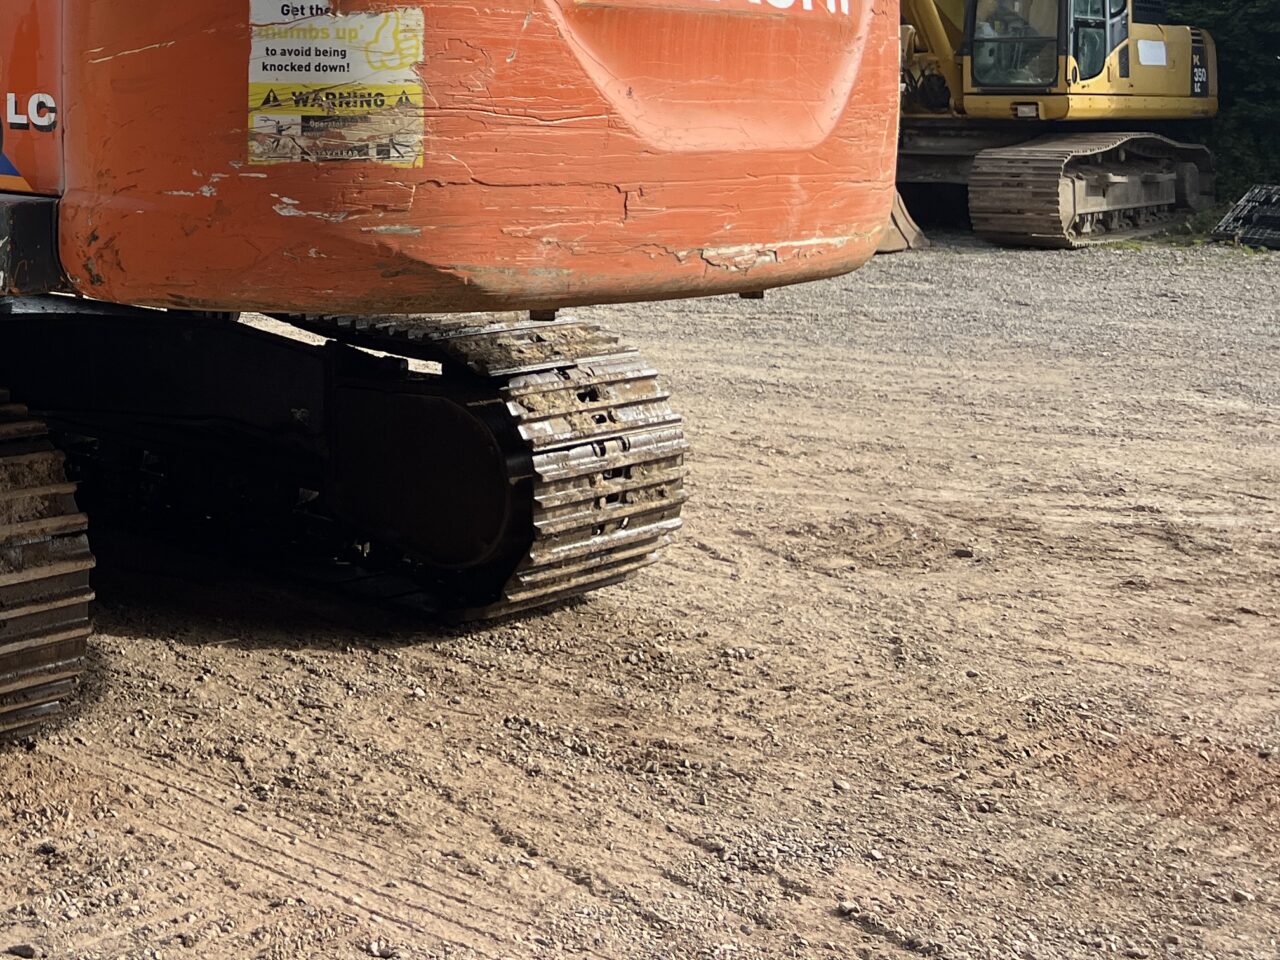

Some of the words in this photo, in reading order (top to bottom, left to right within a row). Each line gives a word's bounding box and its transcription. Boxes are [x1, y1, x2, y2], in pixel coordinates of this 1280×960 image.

[281, 4, 305, 16] Get
[265, 47, 277, 57] to
[280, 46, 312, 57] avoid
[315, 46, 347, 59] being
[261, 61, 311, 73] knocked
[314, 61, 350, 73] down!
[1193, 68, 1207, 82] 350
[291, 90, 386, 108] WARNING
[6, 92, 57, 131] LC
